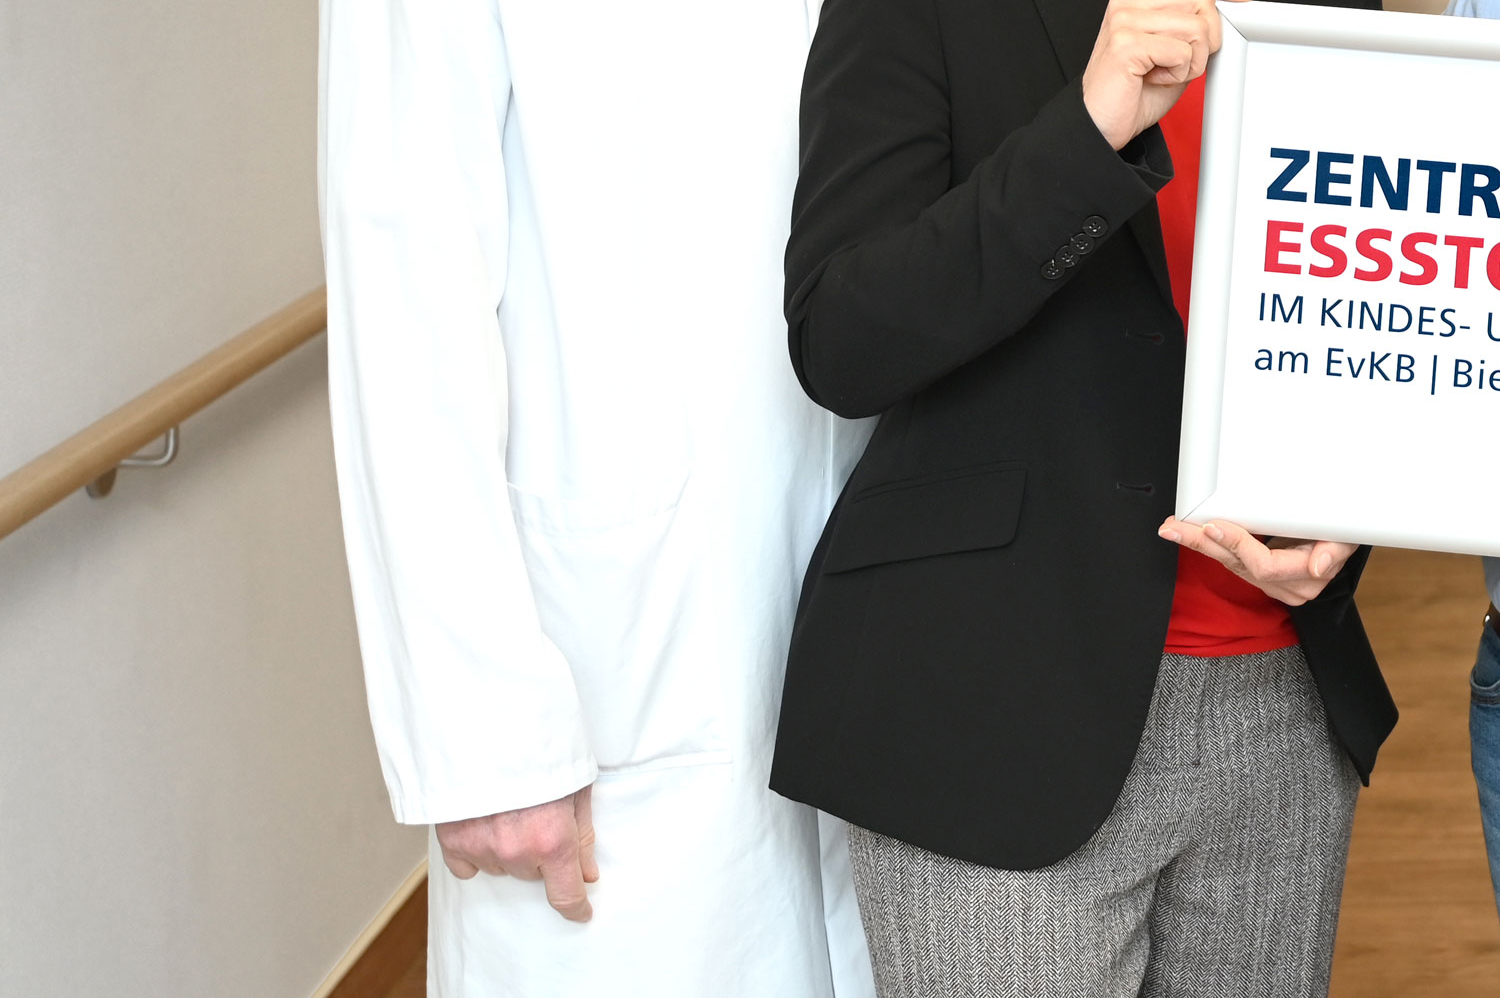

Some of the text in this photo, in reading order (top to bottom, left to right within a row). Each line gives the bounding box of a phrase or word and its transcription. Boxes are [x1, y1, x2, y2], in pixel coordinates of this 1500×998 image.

[1259, 292, 1304, 325] IM
[1320, 297, 1471, 338] KINDES-
[1254, 348, 1309, 374] am
[1325, 347, 1415, 383] EvKB
